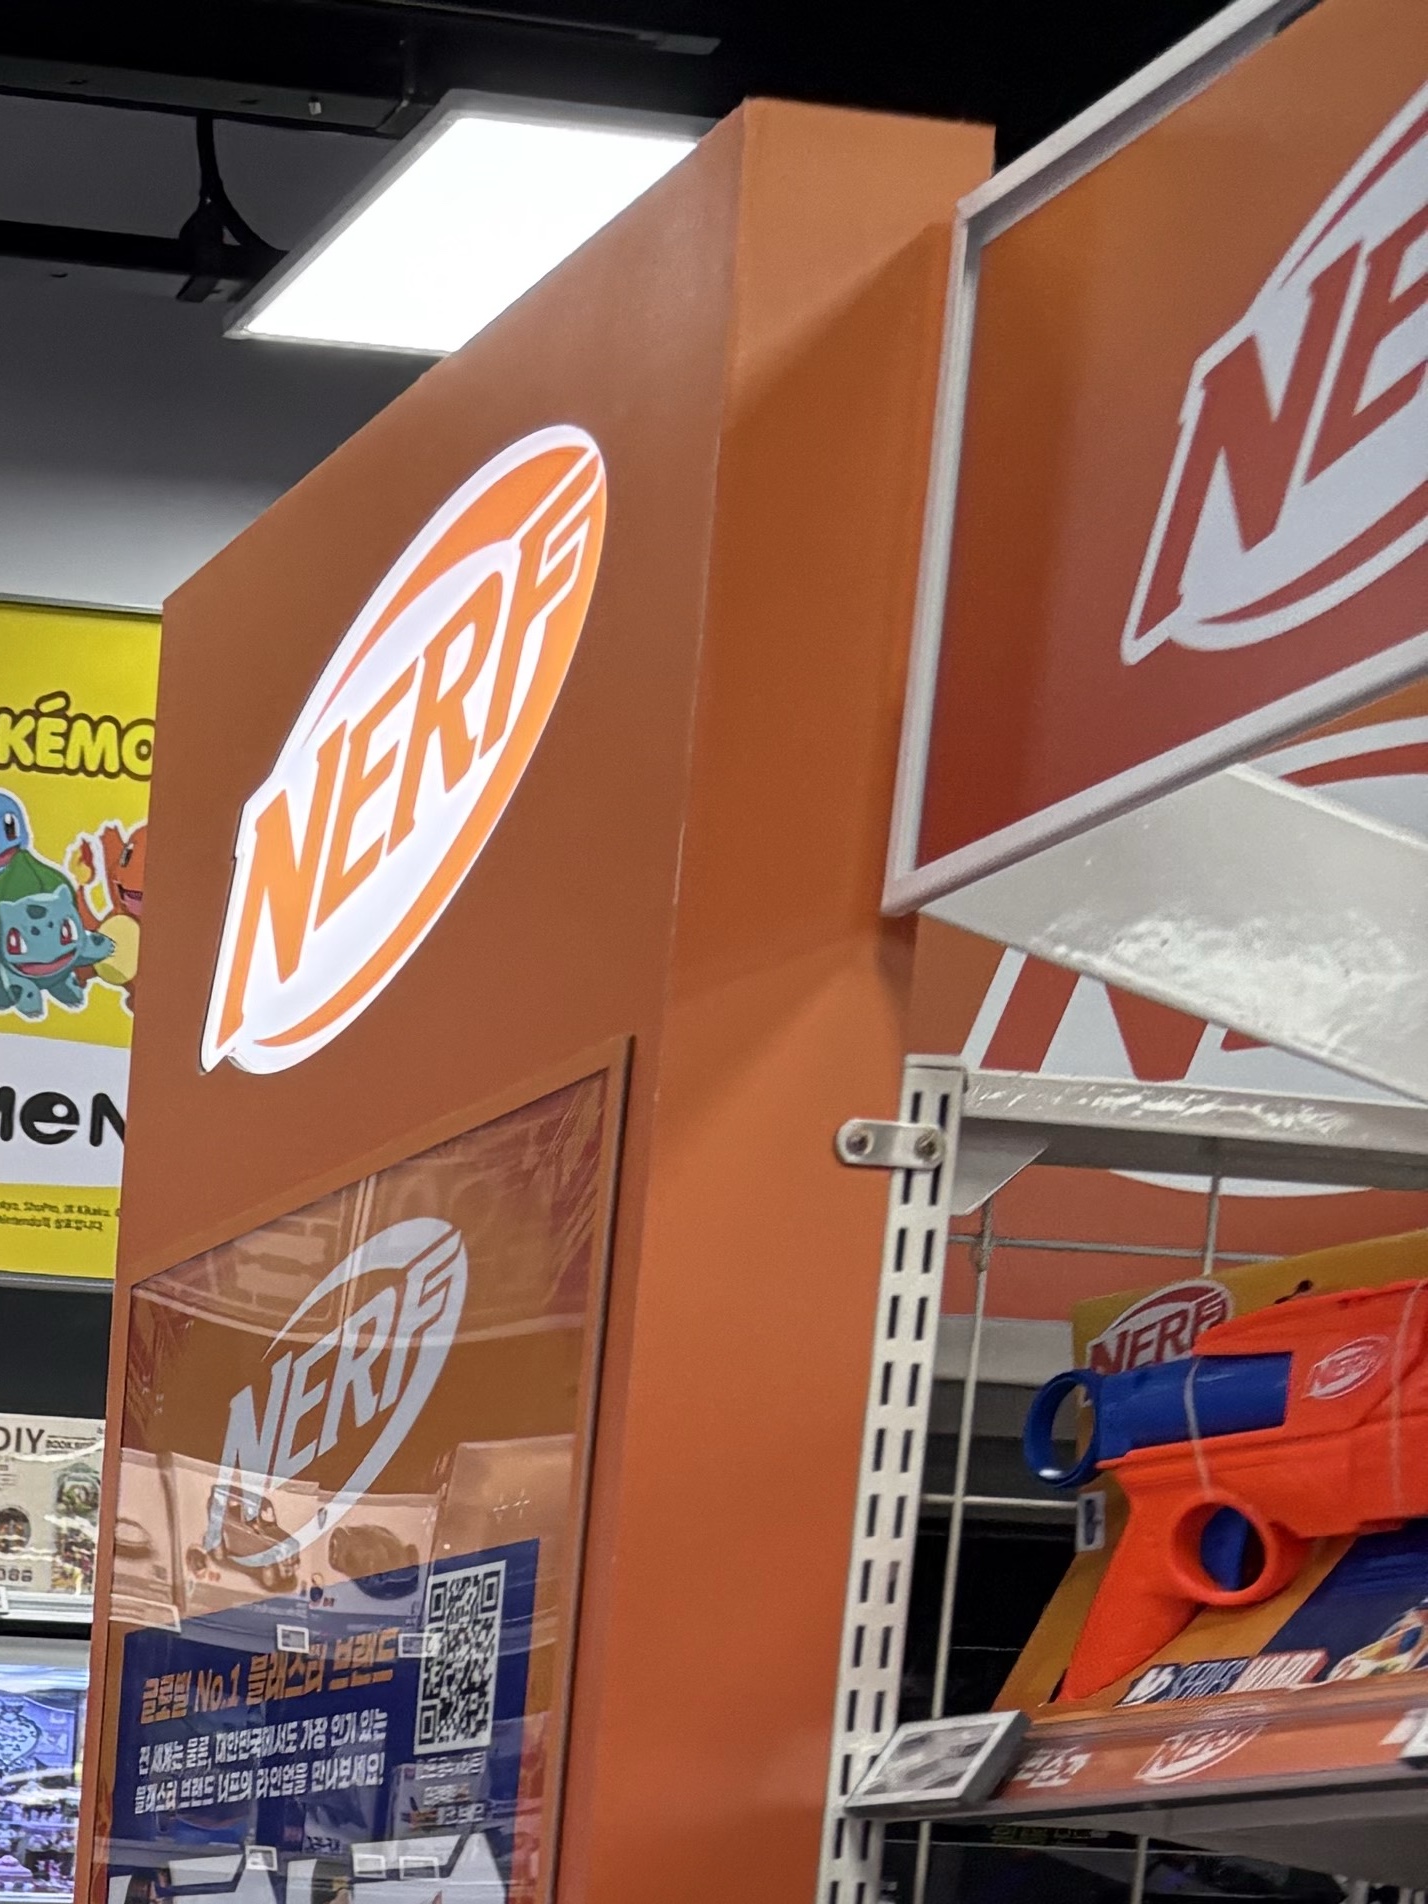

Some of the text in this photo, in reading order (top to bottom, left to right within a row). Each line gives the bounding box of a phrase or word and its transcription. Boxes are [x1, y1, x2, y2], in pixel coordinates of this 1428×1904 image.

[214, 450, 597, 1050] NERF
[1088, 1292, 1227, 1375] NERF
[203, 1255, 466, 1553] NERF
[140, 1670, 193, 1725] 글로벌
[195, 1664, 241, 1714] No.1
[329, 1628, 400, 1692] 브랜드
[179, 1775, 215, 1810] 브랜드
[216, 1769, 253, 1804] 너프의
[310, 1751, 386, 1793] 만나보세요!
[186, 1735, 212, 1772] 물론,
[214, 1719, 298, 1764] 대한민국에서도
[300, 1717, 328, 1751] 가장
[330, 1711, 357, 1747] 인기
[359, 1707, 388, 1742] 있는
